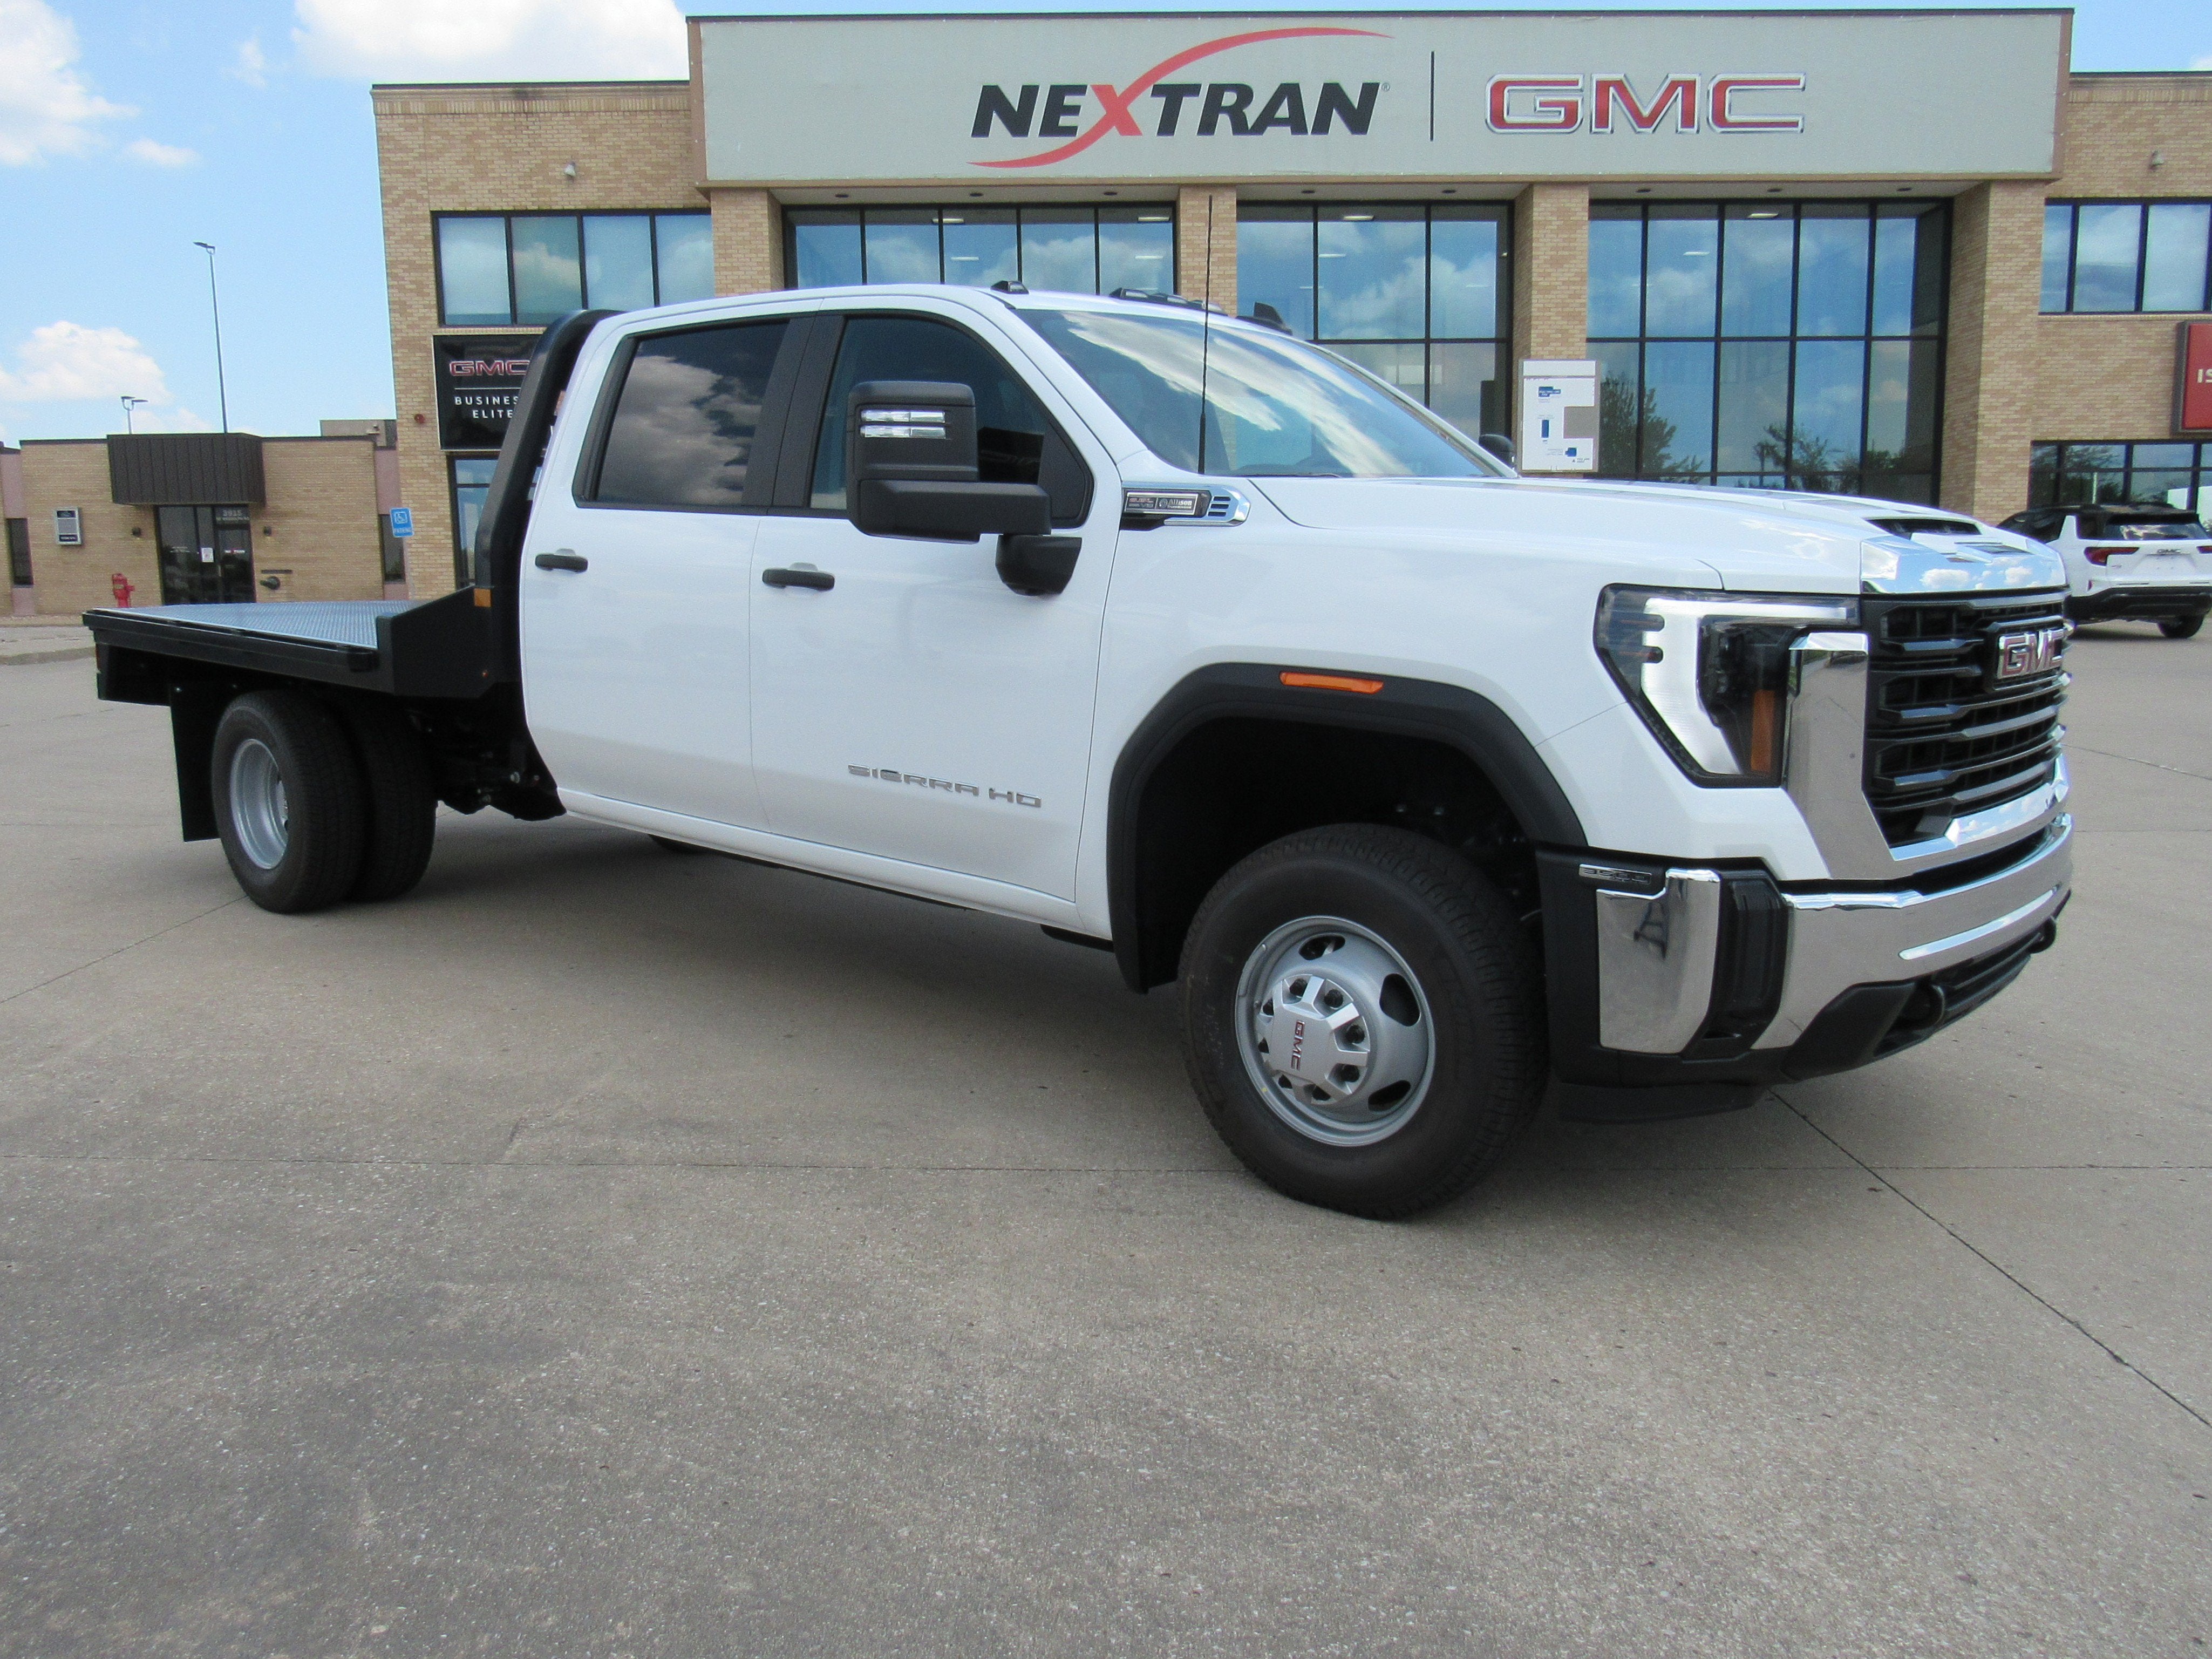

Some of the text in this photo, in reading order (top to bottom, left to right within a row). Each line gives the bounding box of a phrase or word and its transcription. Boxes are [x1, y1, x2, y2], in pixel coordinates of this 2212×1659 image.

[971, 82, 1380, 138] NEXTRAN
[1485, 73, 1806, 134] GMC
[450, 359, 530, 377] GMC
[454, 396, 519, 405] BUSINES
[472, 410, 513, 419] ELITE
[1997, 628, 2064, 679] GMC
[848, 764, 1043, 808] SIERRA HD
[1290, 1019, 1305, 1071] GMC
